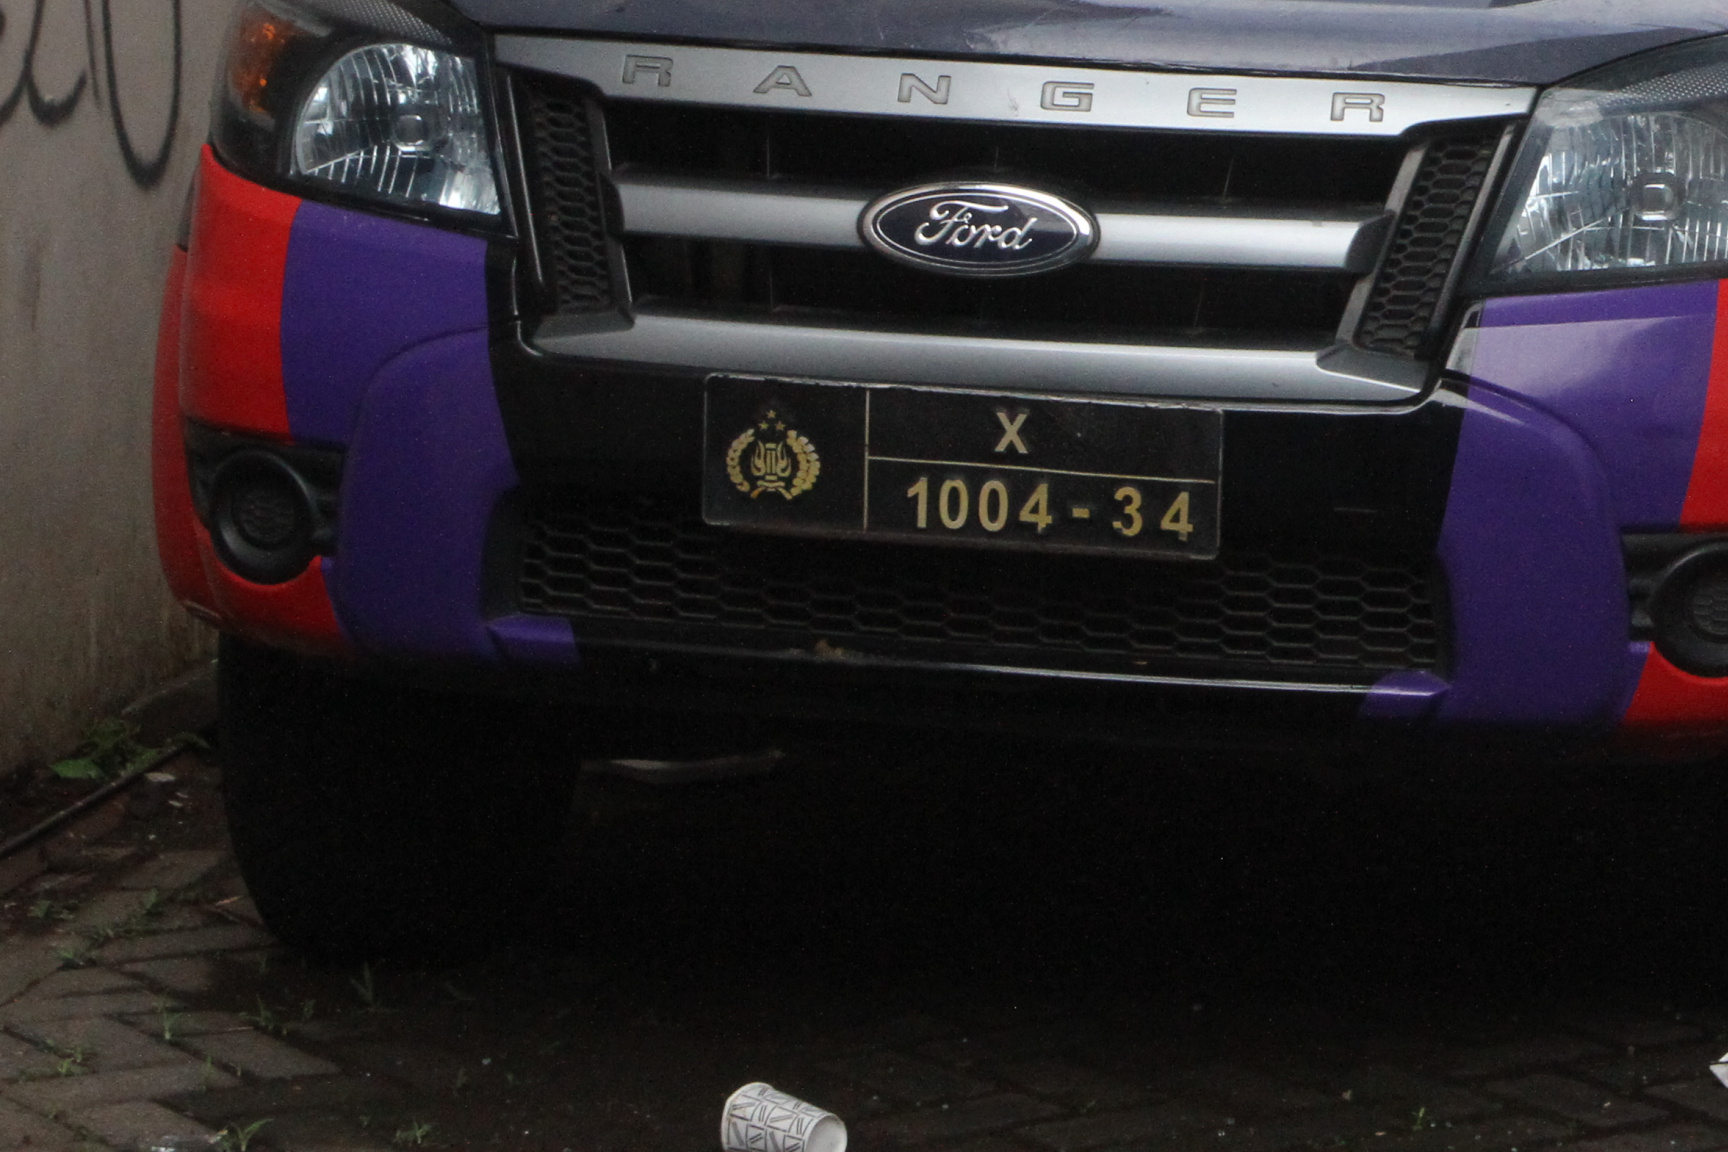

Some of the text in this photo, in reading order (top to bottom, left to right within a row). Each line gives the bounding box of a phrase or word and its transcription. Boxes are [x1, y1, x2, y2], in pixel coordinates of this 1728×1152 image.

[621, 54, 1385, 123] RANGER
[913, 200, 1038, 250] Ford
[994, 411, 1029, 454] X
